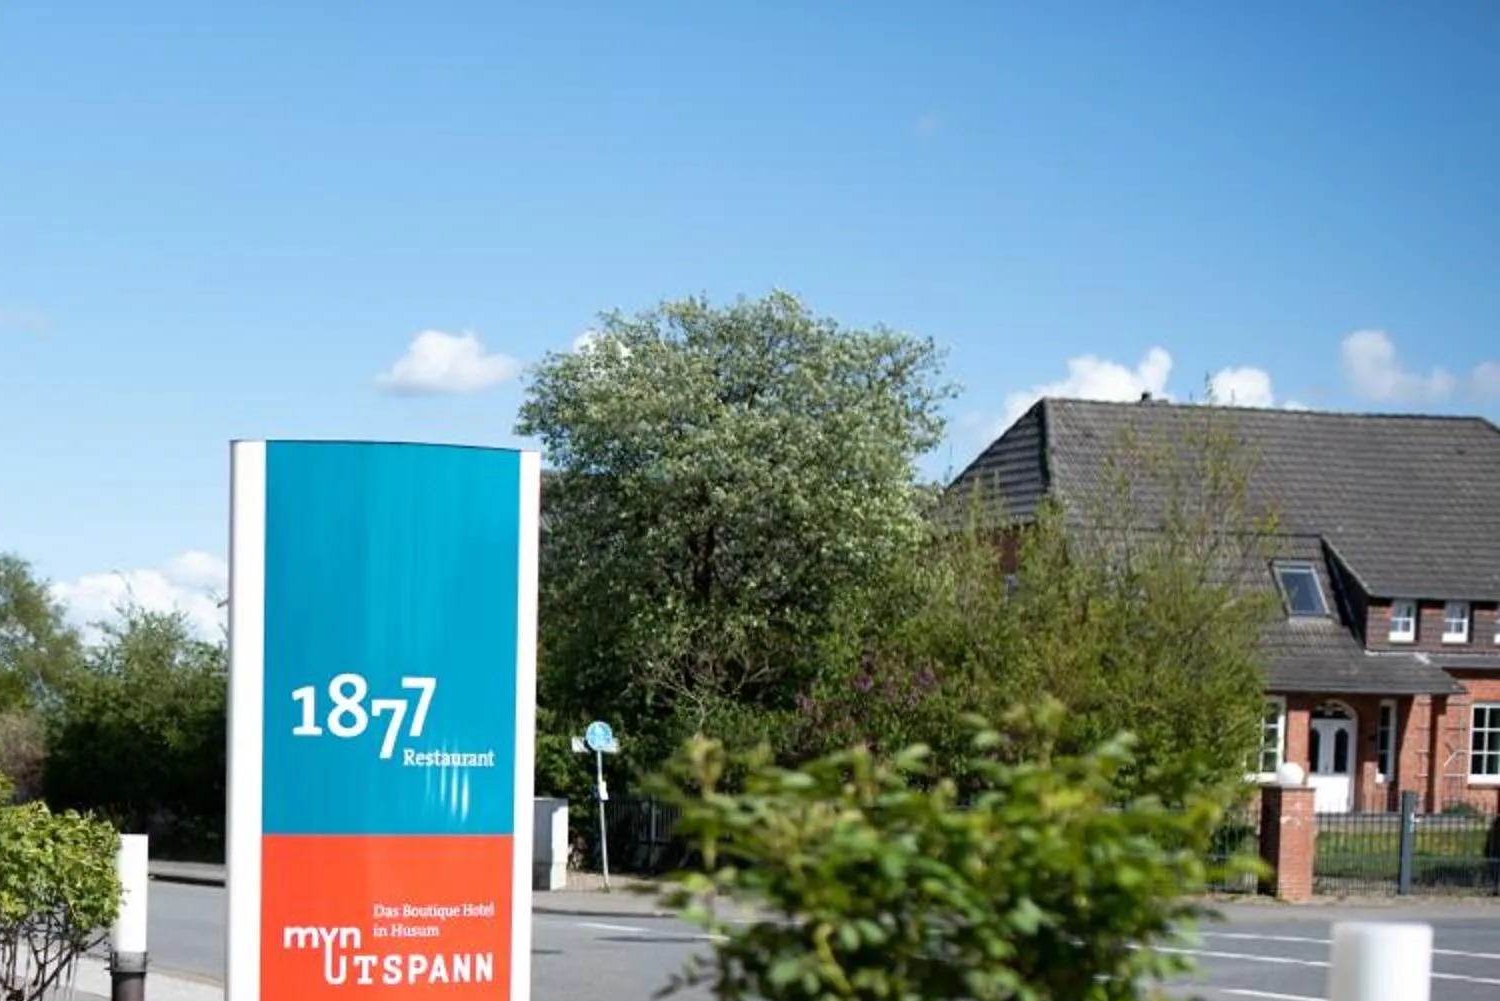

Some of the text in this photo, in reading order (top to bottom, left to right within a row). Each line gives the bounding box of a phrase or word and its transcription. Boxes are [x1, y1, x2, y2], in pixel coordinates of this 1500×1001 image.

[292, 673, 436, 759] 1877
[403, 748, 495, 767] Restaurant
[373, 902, 495, 920] Das Boutique Hotel
[283, 926, 361, 949] myn
[373, 924, 440, 937] in Husum
[324, 953, 494, 985] UTSPANN
